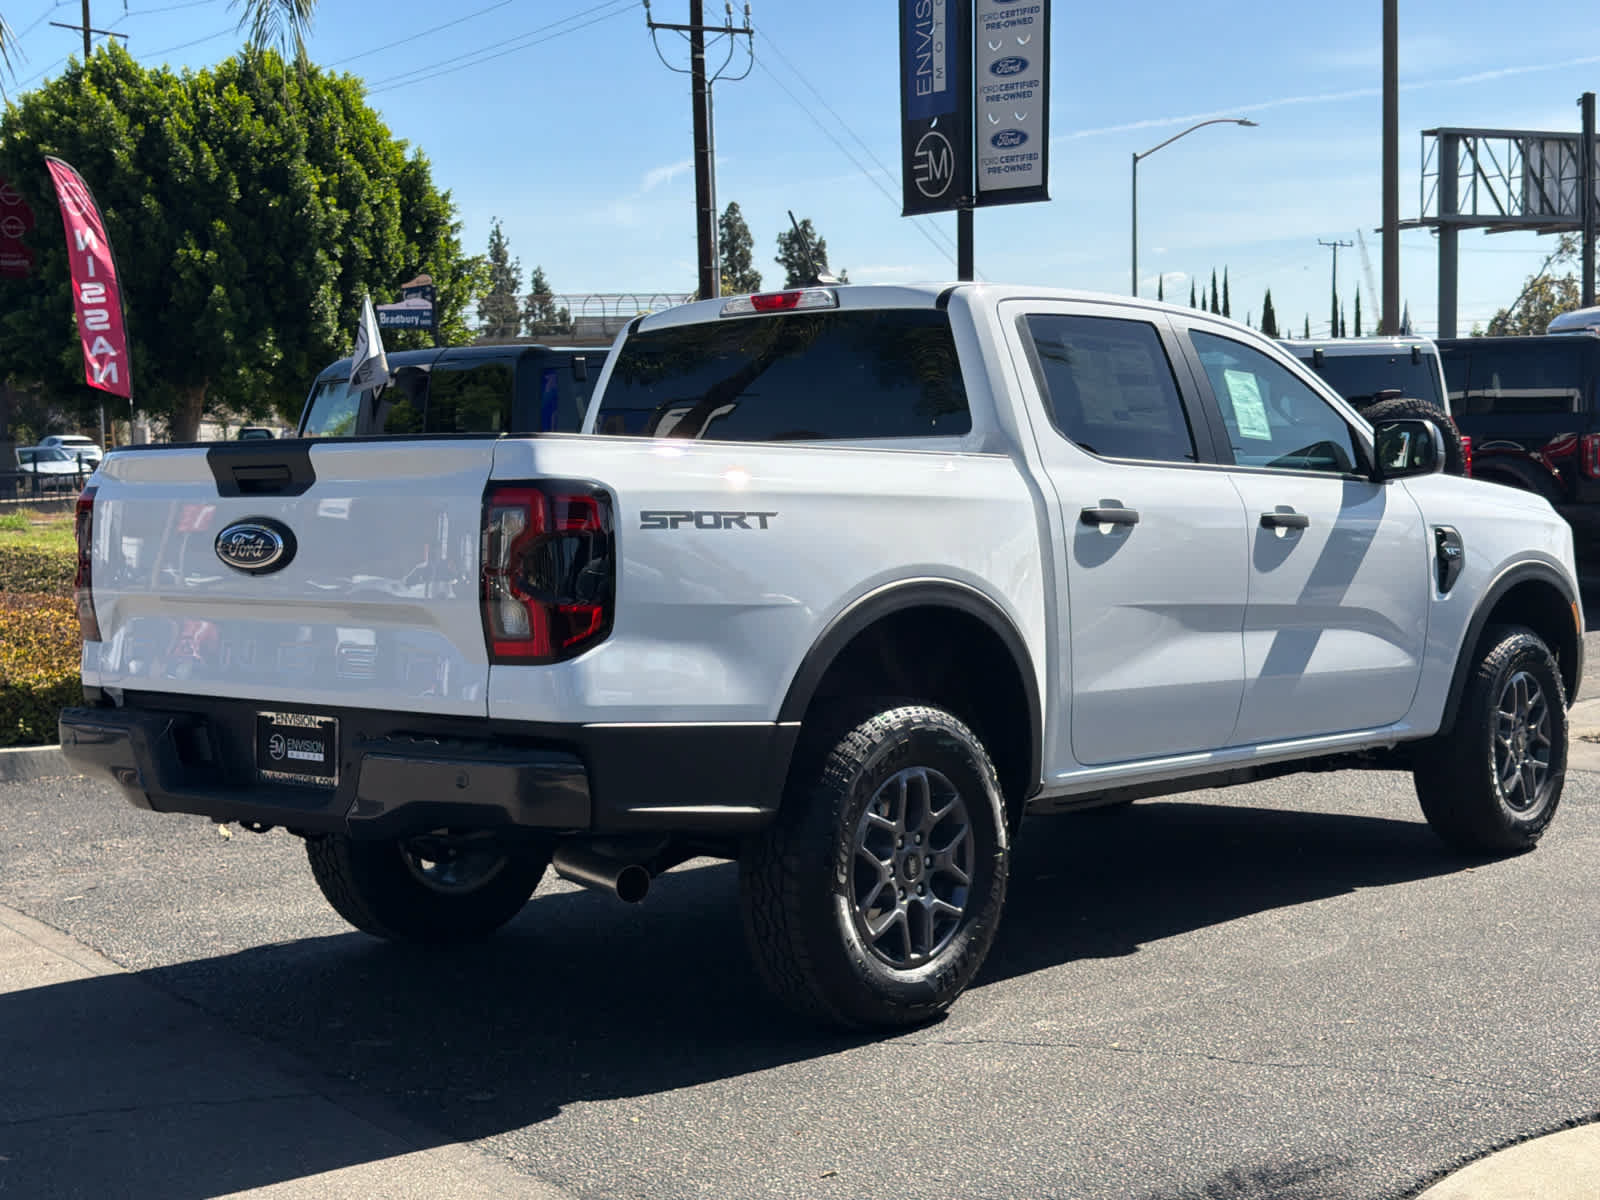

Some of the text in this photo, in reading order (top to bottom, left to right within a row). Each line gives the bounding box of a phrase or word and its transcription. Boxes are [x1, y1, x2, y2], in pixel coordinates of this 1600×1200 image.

[985, 16, 1034, 31] PRE-OWNED
[985, 90, 1033, 103] PRE-OWNED
[987, 163, 1033, 175] PRE-OWNED
[379, 312, 419, 325] Bradbury
[639, 510, 779, 530] SPORT
[228, 533, 265, 558] Ford
[275, 713, 317, 727] ENVISION
[287, 738, 324, 753] ENVISION
